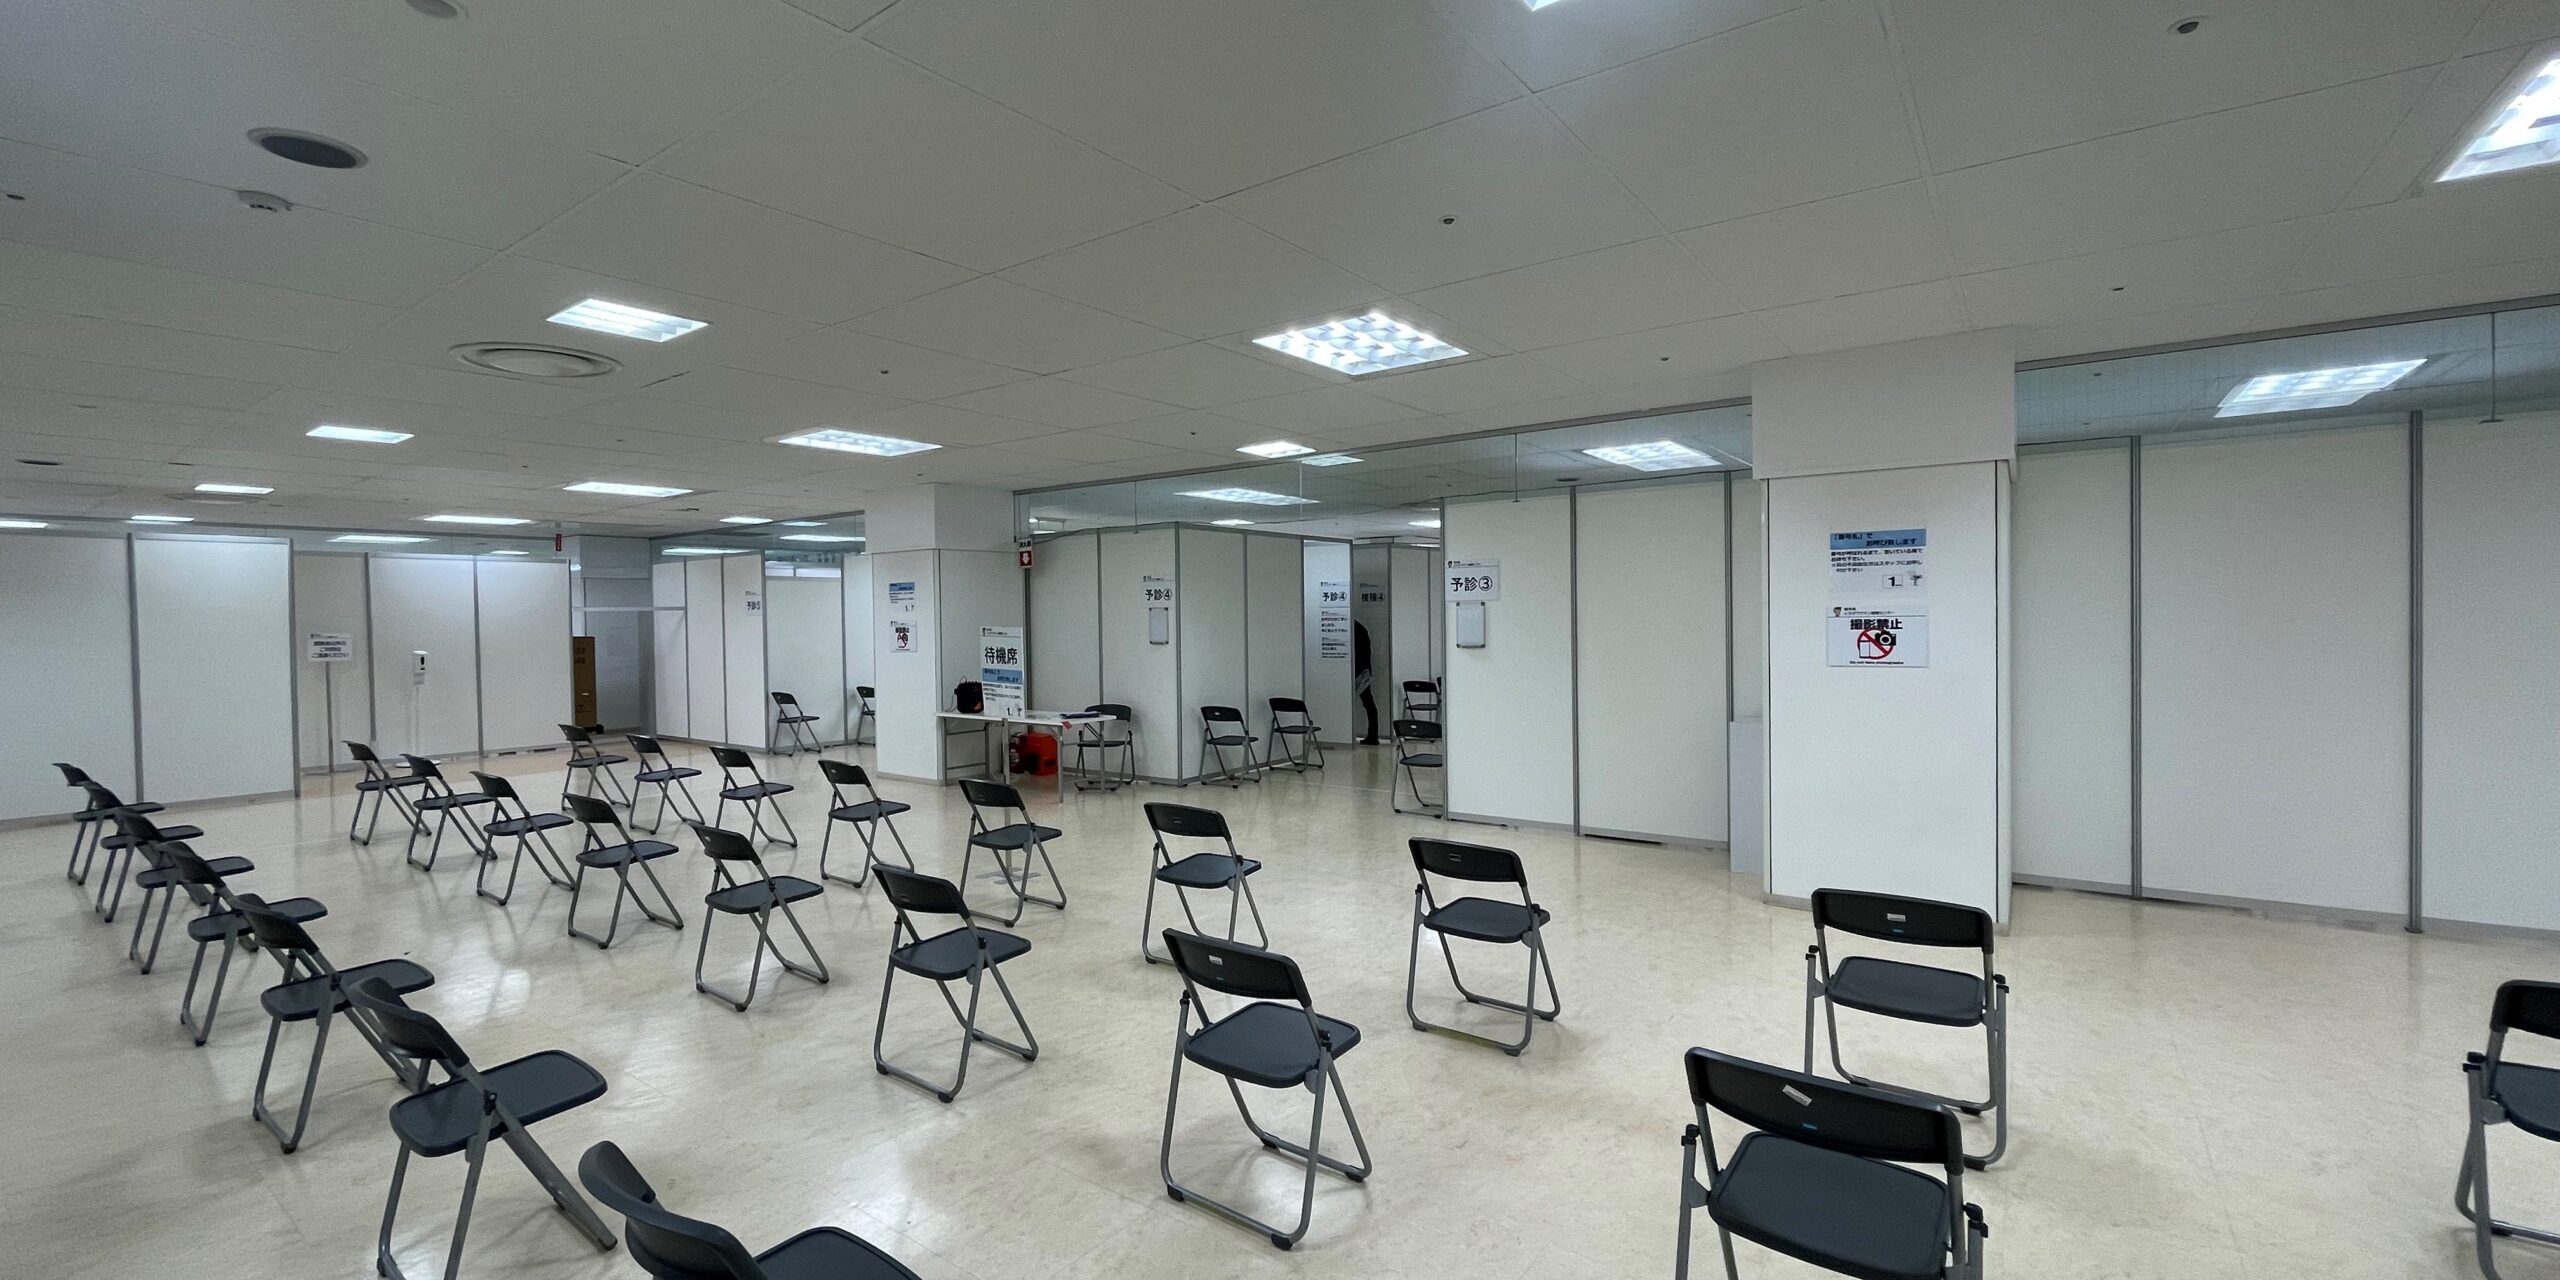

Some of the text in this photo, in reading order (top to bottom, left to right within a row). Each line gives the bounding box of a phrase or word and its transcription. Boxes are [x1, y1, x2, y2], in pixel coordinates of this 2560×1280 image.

[1450, 575, 1493, 592] 予診③
[1145, 588, 1173, 601] 予診④
[984, 646, 1018, 666] 待機席
